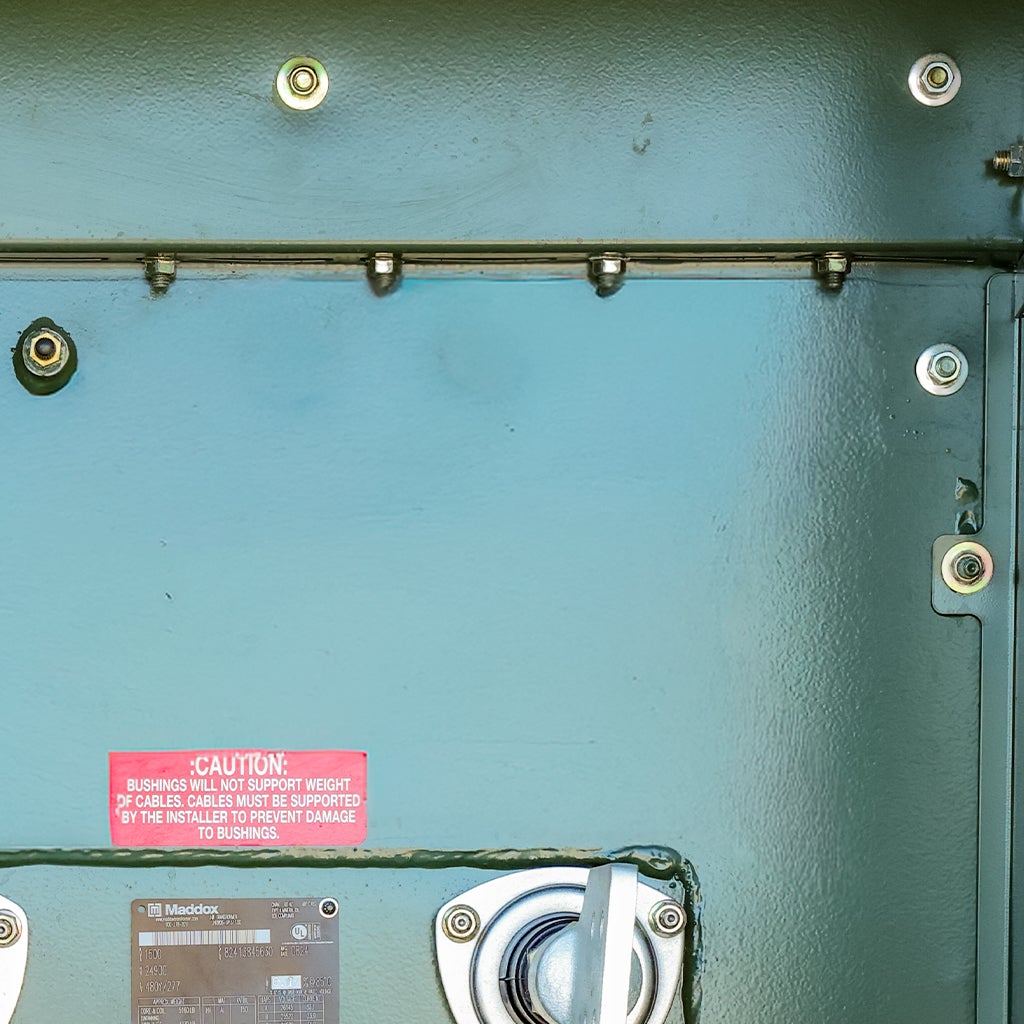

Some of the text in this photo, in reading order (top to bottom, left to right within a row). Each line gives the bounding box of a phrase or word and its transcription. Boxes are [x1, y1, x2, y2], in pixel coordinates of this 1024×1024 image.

[127, 778, 350, 792] BUSHINGS WILL NOT SUPPORT WEIGHT
[136, 795, 184, 808] CABLES.
[187, 795, 232, 808] CABLES
[236, 795, 269, 807] MUST
[272, 795, 287, 807] BE
[290, 794, 360, 807] SUPPORTED
[122, 810, 355, 823] BY THE INSTALLER TO PREVENT DAMAGE
[198, 826, 279, 839] TO BUSHINGS.
[165, 903, 218, 915] Maddox
[145, 949, 161, 960] 1500
